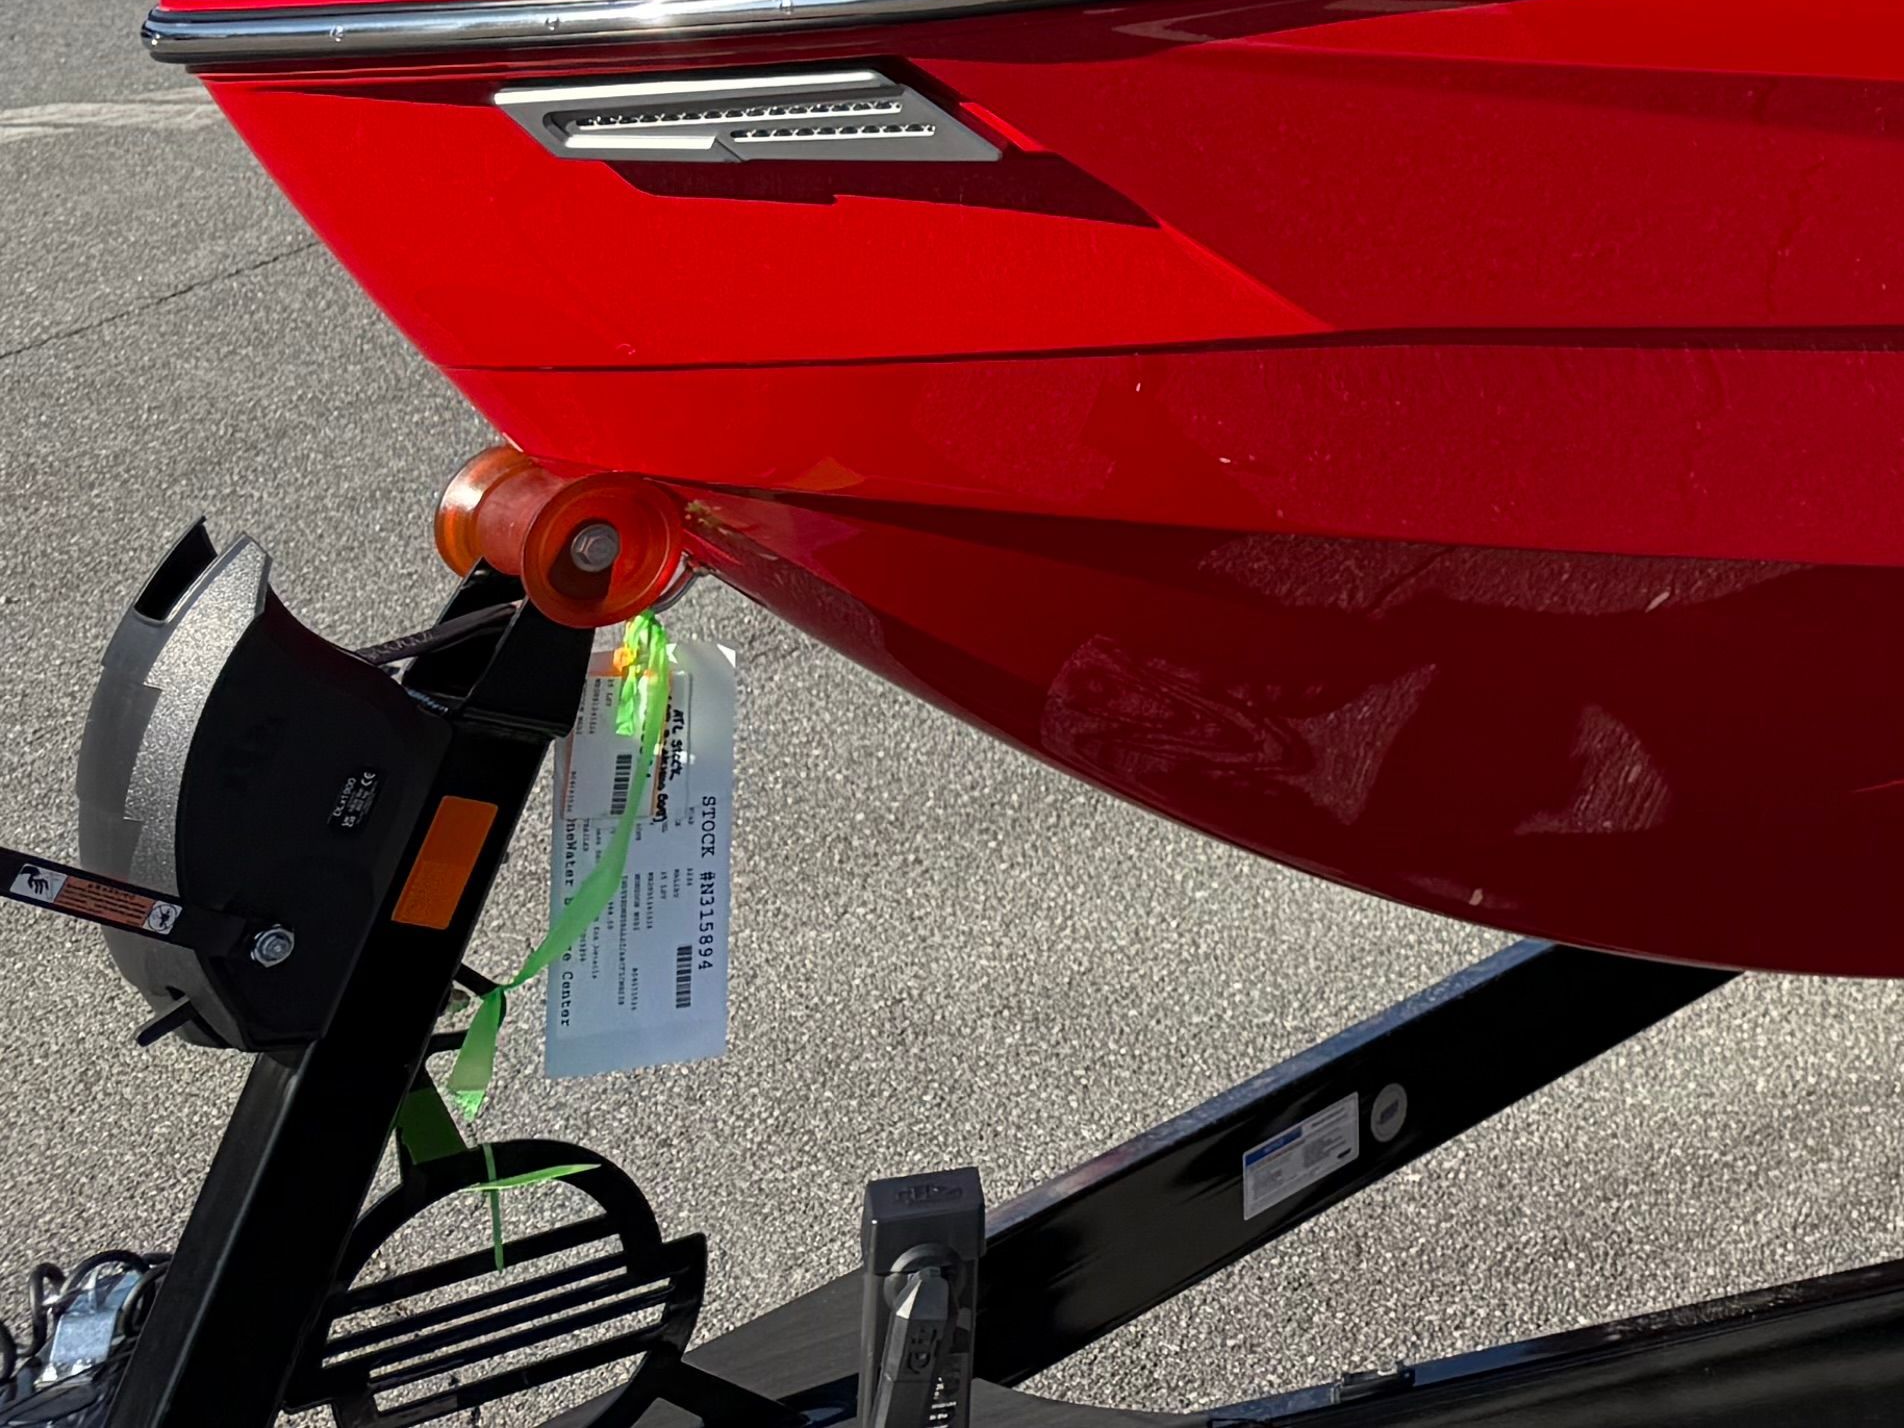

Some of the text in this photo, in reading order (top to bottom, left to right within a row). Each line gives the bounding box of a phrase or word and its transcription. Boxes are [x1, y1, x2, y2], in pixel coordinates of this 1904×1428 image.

[698, 795, 717, 970] STOCK #N315894
[560, 971, 574, 1027] Center
